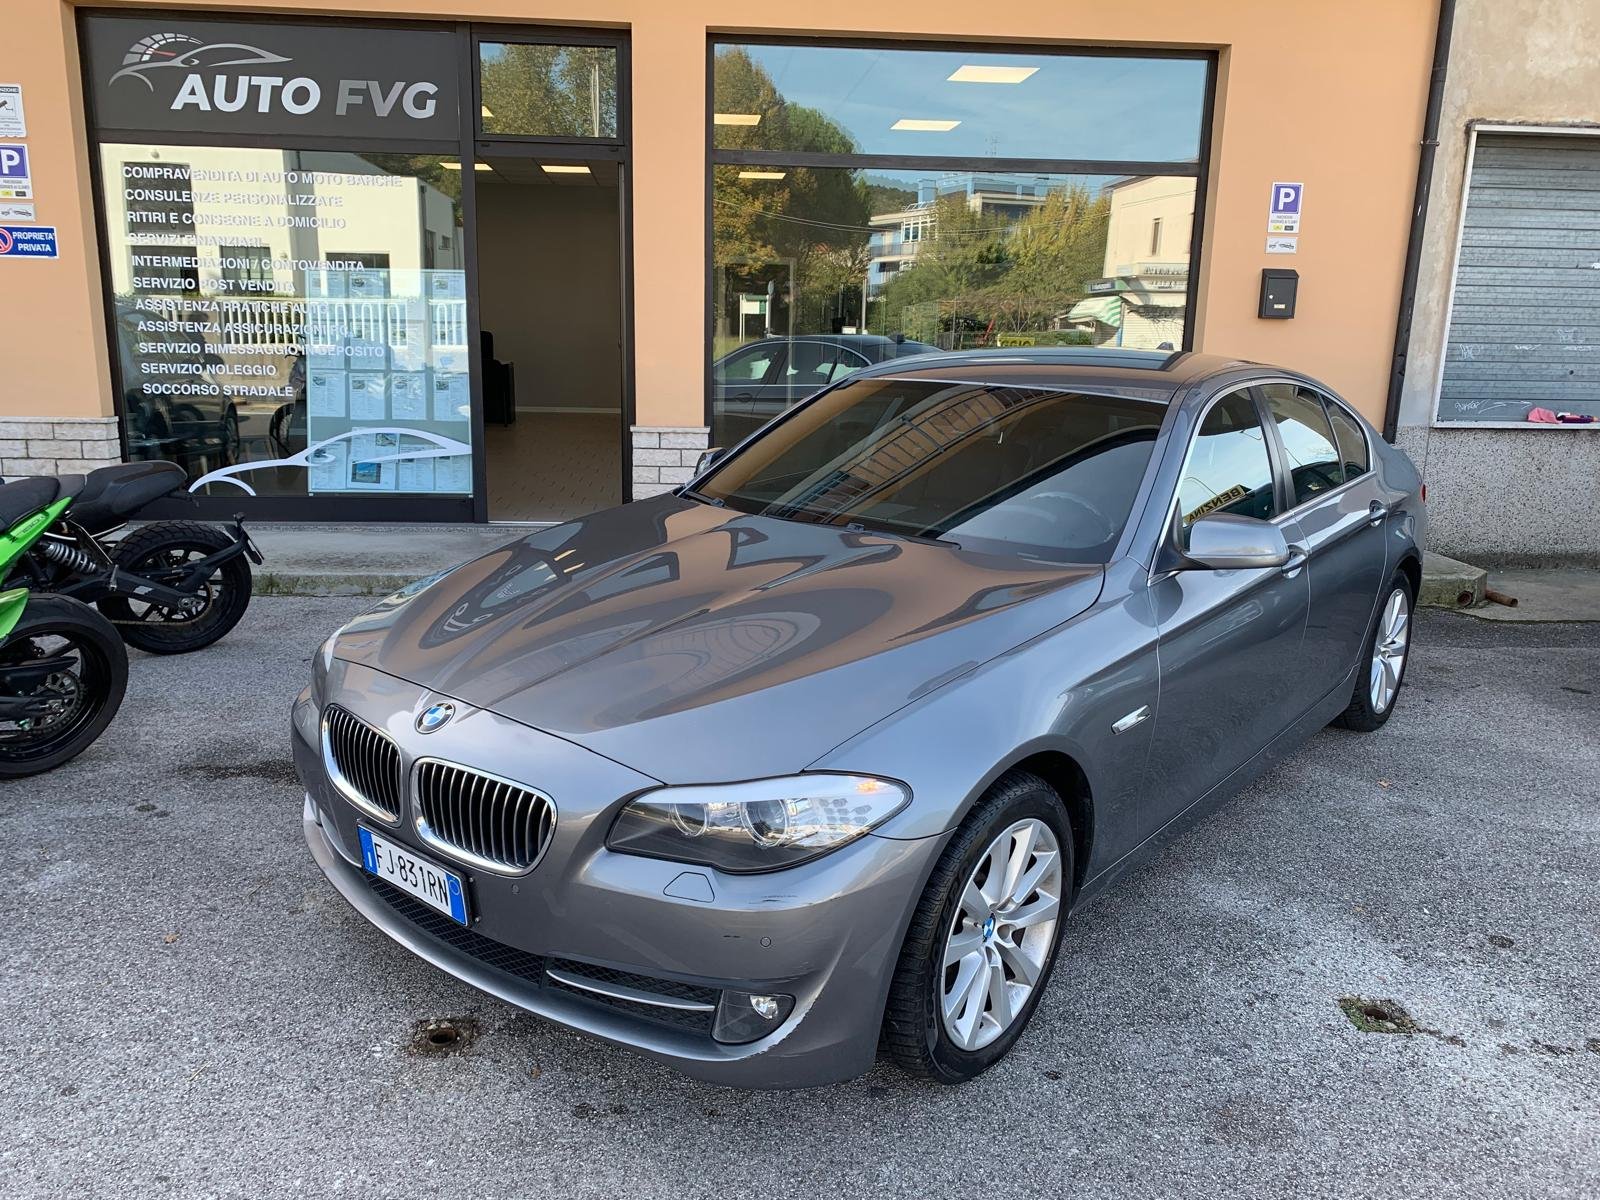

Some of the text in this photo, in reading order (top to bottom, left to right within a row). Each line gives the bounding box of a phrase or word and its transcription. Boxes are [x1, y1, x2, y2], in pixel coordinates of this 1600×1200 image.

[170, 73, 438, 119] AUTO FVG
[2, 150, 20, 174] P
[123, 166, 403, 187] COMPRAVENDITA DI AUTO MOTO BARCHE
[124, 189, 343, 207] CONSULENZE PERSONALIZZATE
[1278, 187, 1296, 211] P
[127, 211, 346, 229] RITIRI E CONSEGNE A DOMICILIO
[18, 243, 51, 252] PRIVATA
[128, 232, 261, 248] SERVIZI FINANZIARI
[132, 255, 250, 269] INTERMEDIAZIONI
[261, 259, 365, 271] CONTOVENDITA
[133, 277, 295, 292] SERVIZIO POST VENDITA
[135, 298, 329, 314] ASSISTENZA PRATICHE AUTO
[138, 320, 221, 332] ASSISTENZA
[224, 322, 327, 335] ASSICURAZIONI
[140, 342, 200, 353] SERVIZIO
[204, 343, 298, 355] RIMESSAGGIO
[318, 345, 385, 357] DEPOSITO
[141, 362, 277, 376] SERVIZIO NOLEGGIO
[142, 383, 293, 397] SOCCORSO STRADALE
